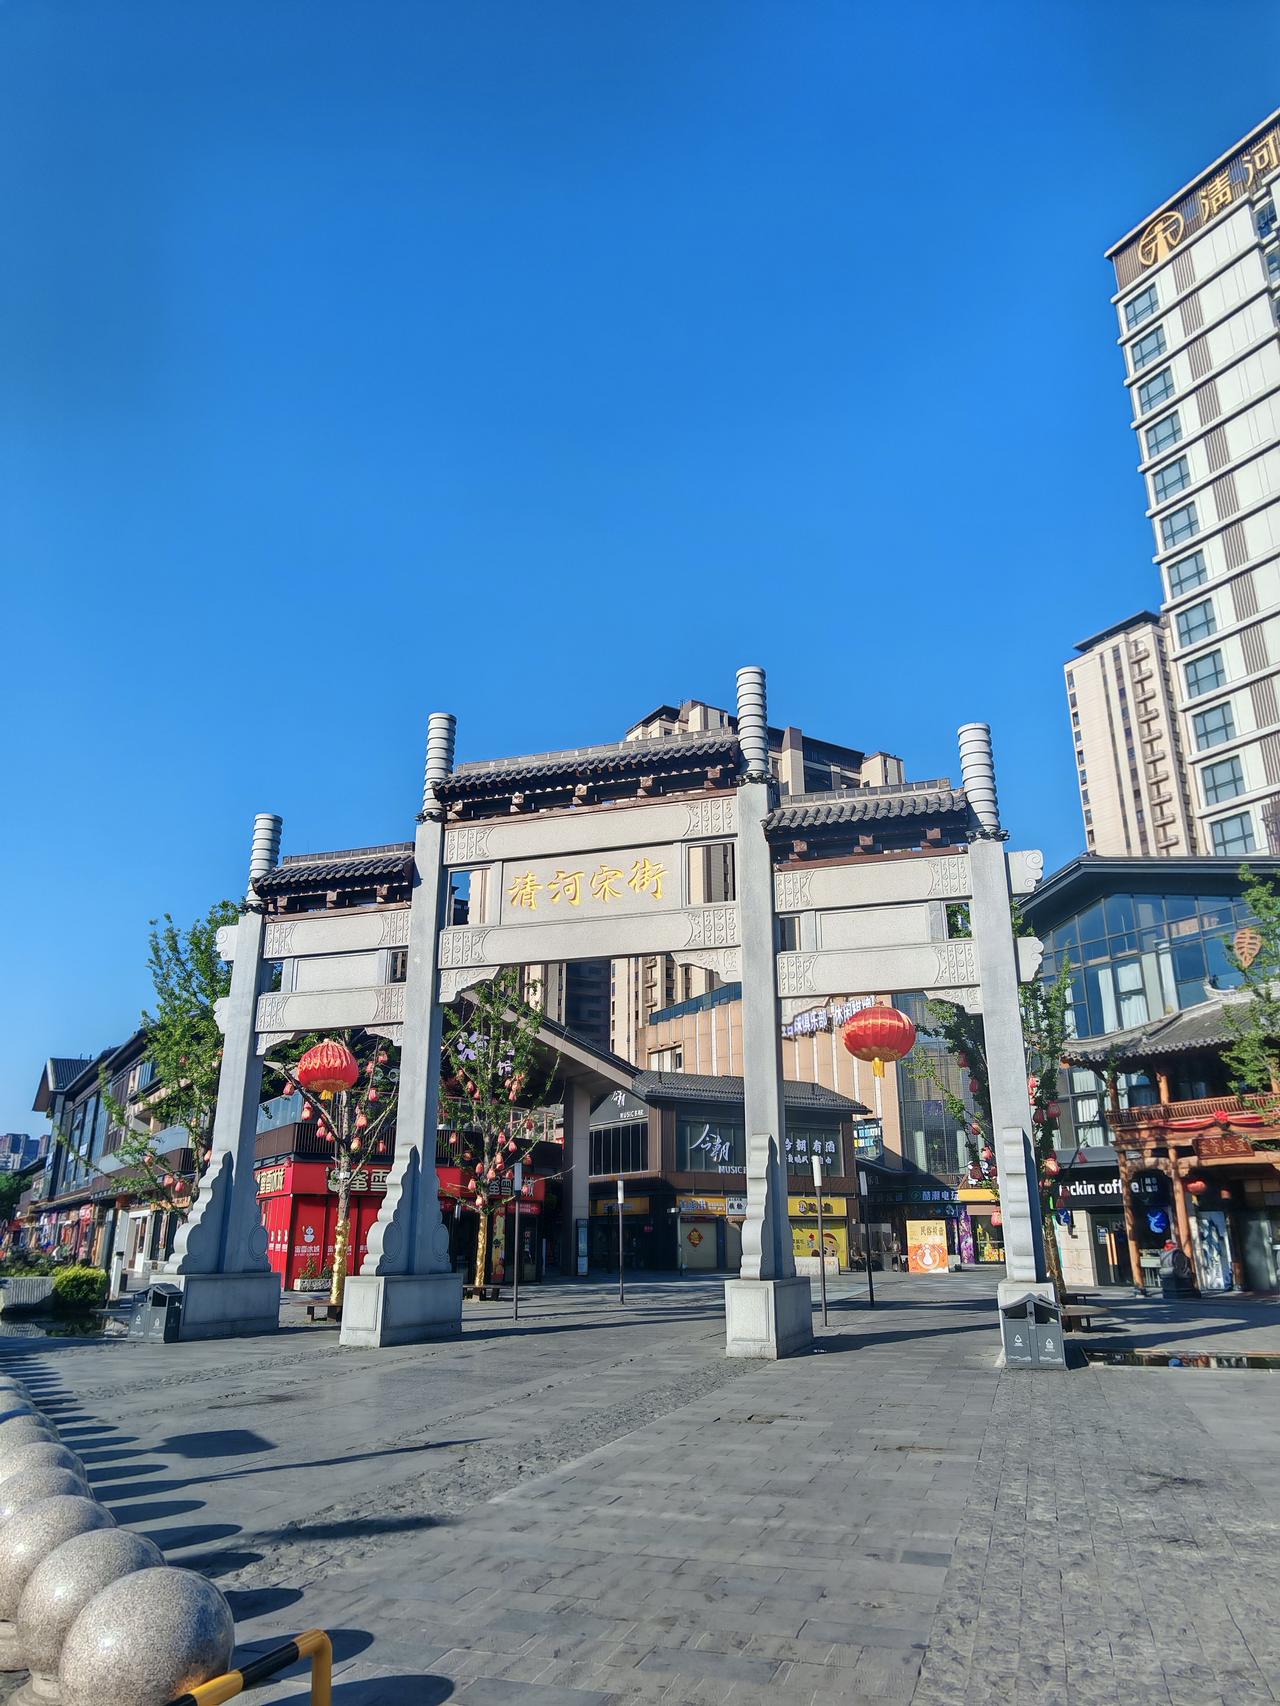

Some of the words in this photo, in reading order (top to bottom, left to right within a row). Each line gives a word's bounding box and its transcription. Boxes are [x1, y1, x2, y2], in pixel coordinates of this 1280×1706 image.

[507, 858, 669, 911] 清河宋街
[635, 1109, 644, 1117] BAR
[690, 1123, 730, 1162] 今朝
[785, 1138, 835, 1153] 今朝有酒
[718, 1165, 742, 1175] MUSIC
[1059, 1180, 1096, 1196] lckin
[1098, 1179, 1139, 1195] coffe
